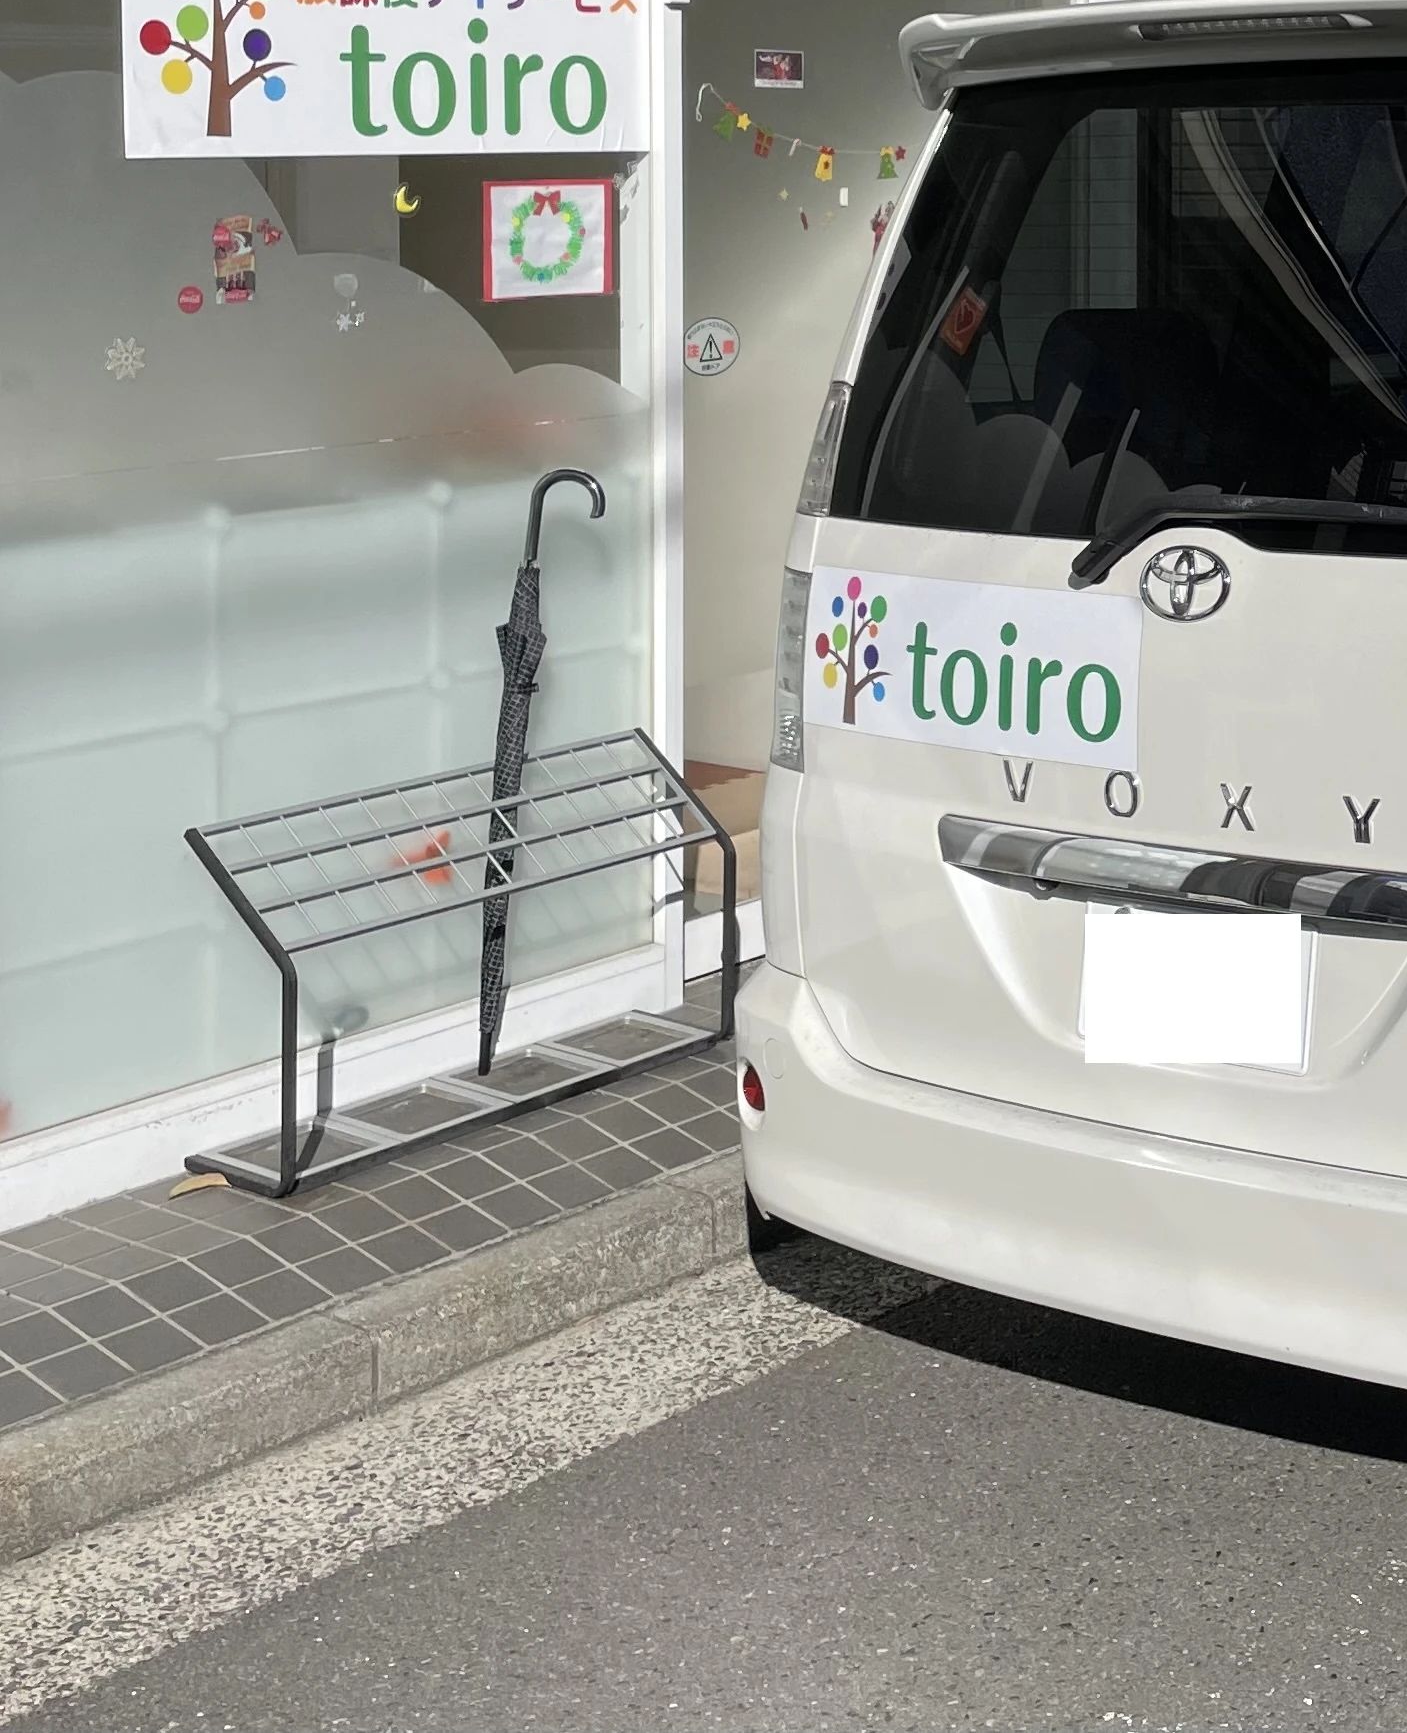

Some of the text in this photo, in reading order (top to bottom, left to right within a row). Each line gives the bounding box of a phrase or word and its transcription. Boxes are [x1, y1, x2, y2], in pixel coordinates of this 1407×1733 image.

[339, 17, 608, 137] toiro
[906, 621, 1122, 743] toiro
[1003, 759, 1380, 844] VOXY
